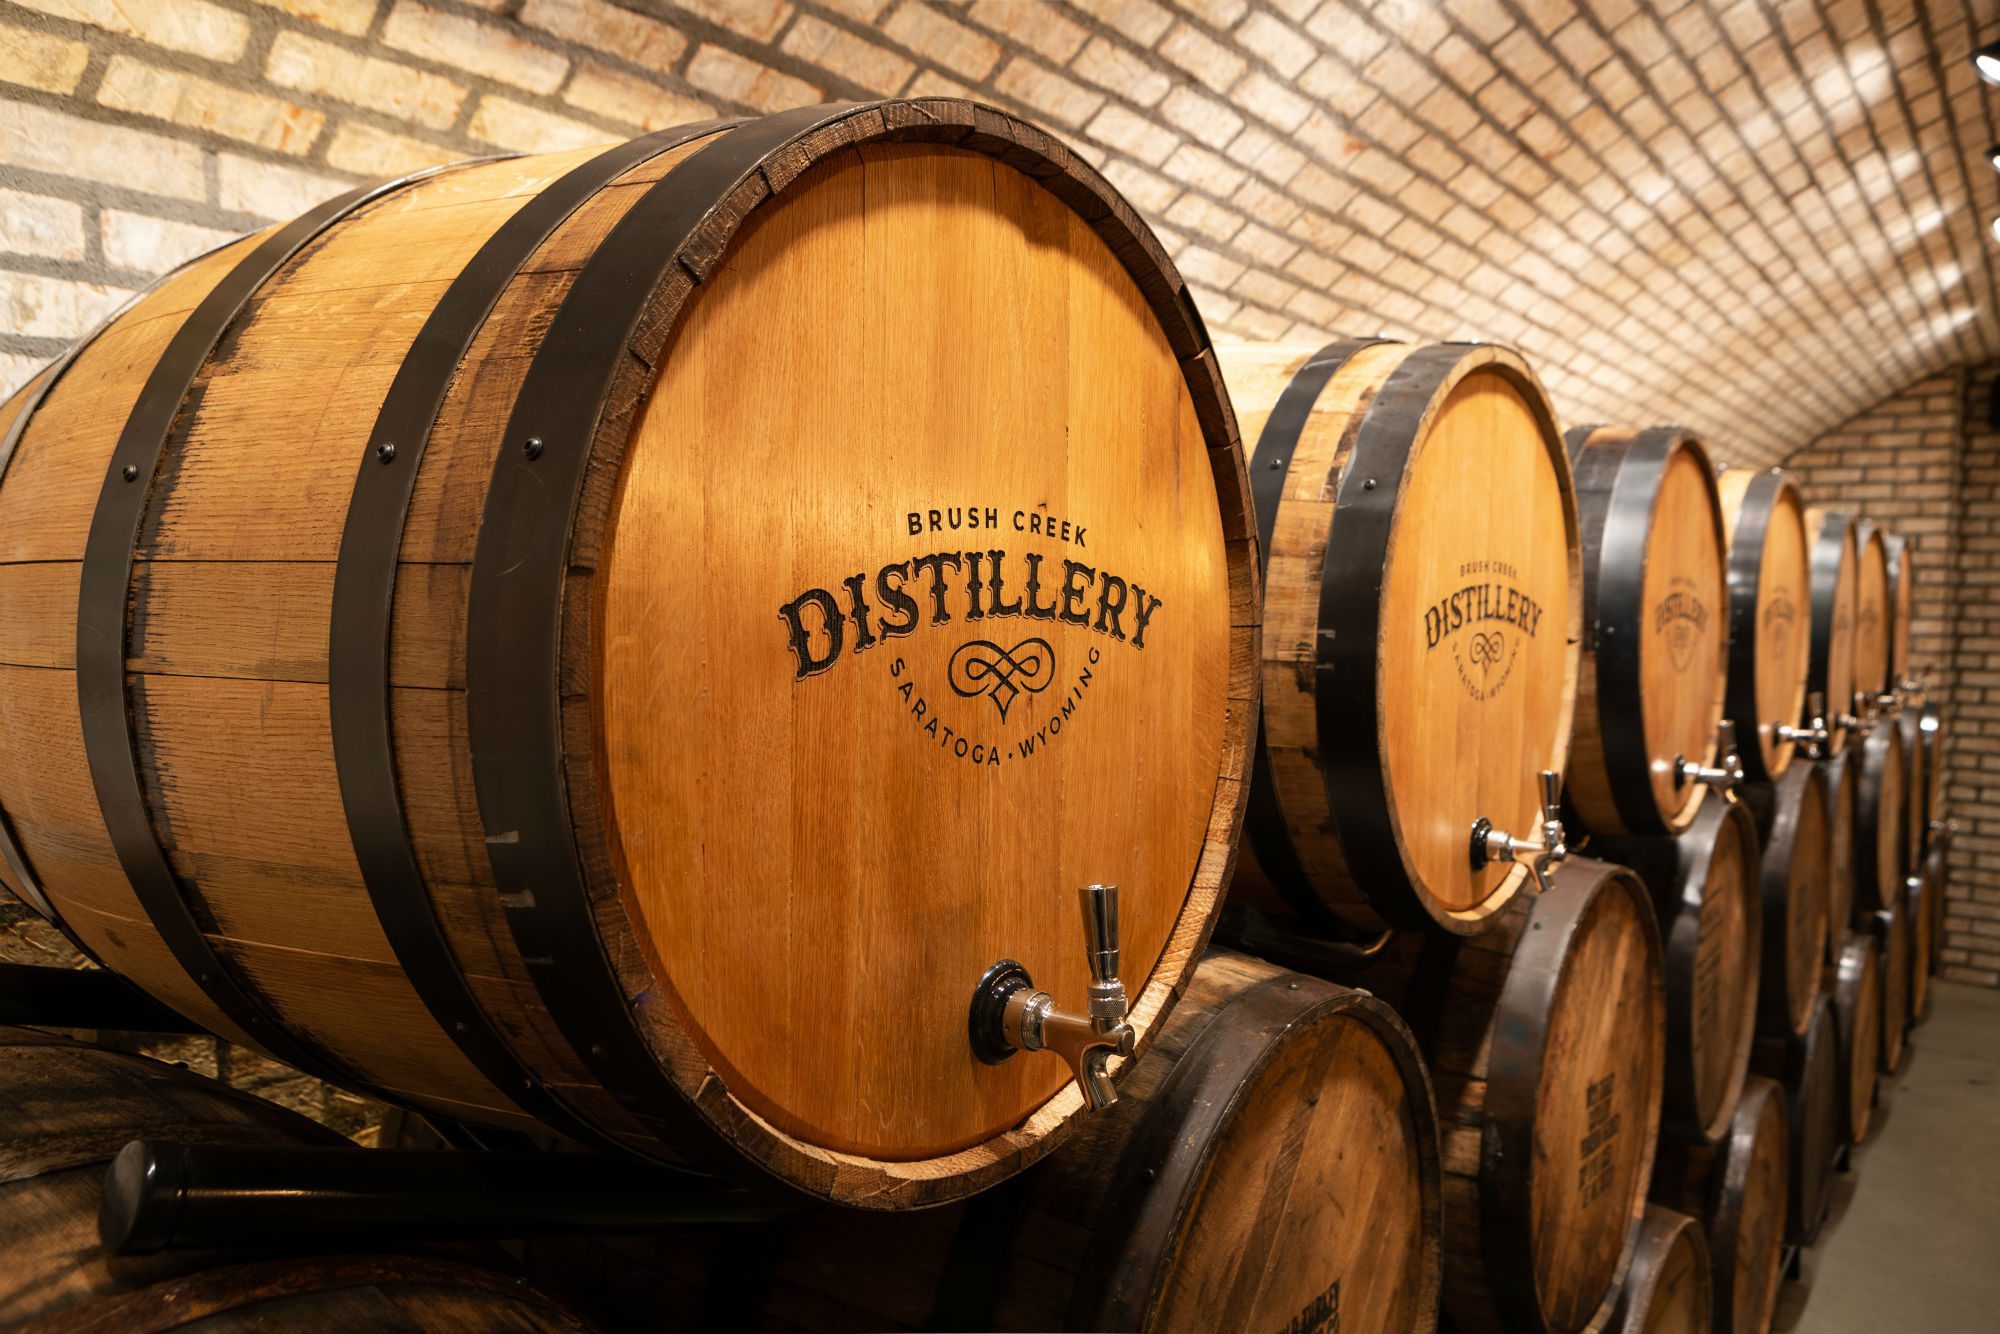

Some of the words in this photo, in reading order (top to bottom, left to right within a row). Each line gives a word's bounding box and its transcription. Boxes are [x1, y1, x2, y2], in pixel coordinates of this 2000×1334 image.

[907, 507, 999, 537] BRUSH
[1012, 510, 1089, 548] CREEK
[777, 549, 1163, 683] DISTILLERY
[1424, 583, 1543, 650] DISTILLERY
[889, 657, 1001, 767] SARATOGA
[1018, 646, 1101, 760] WYOMING
